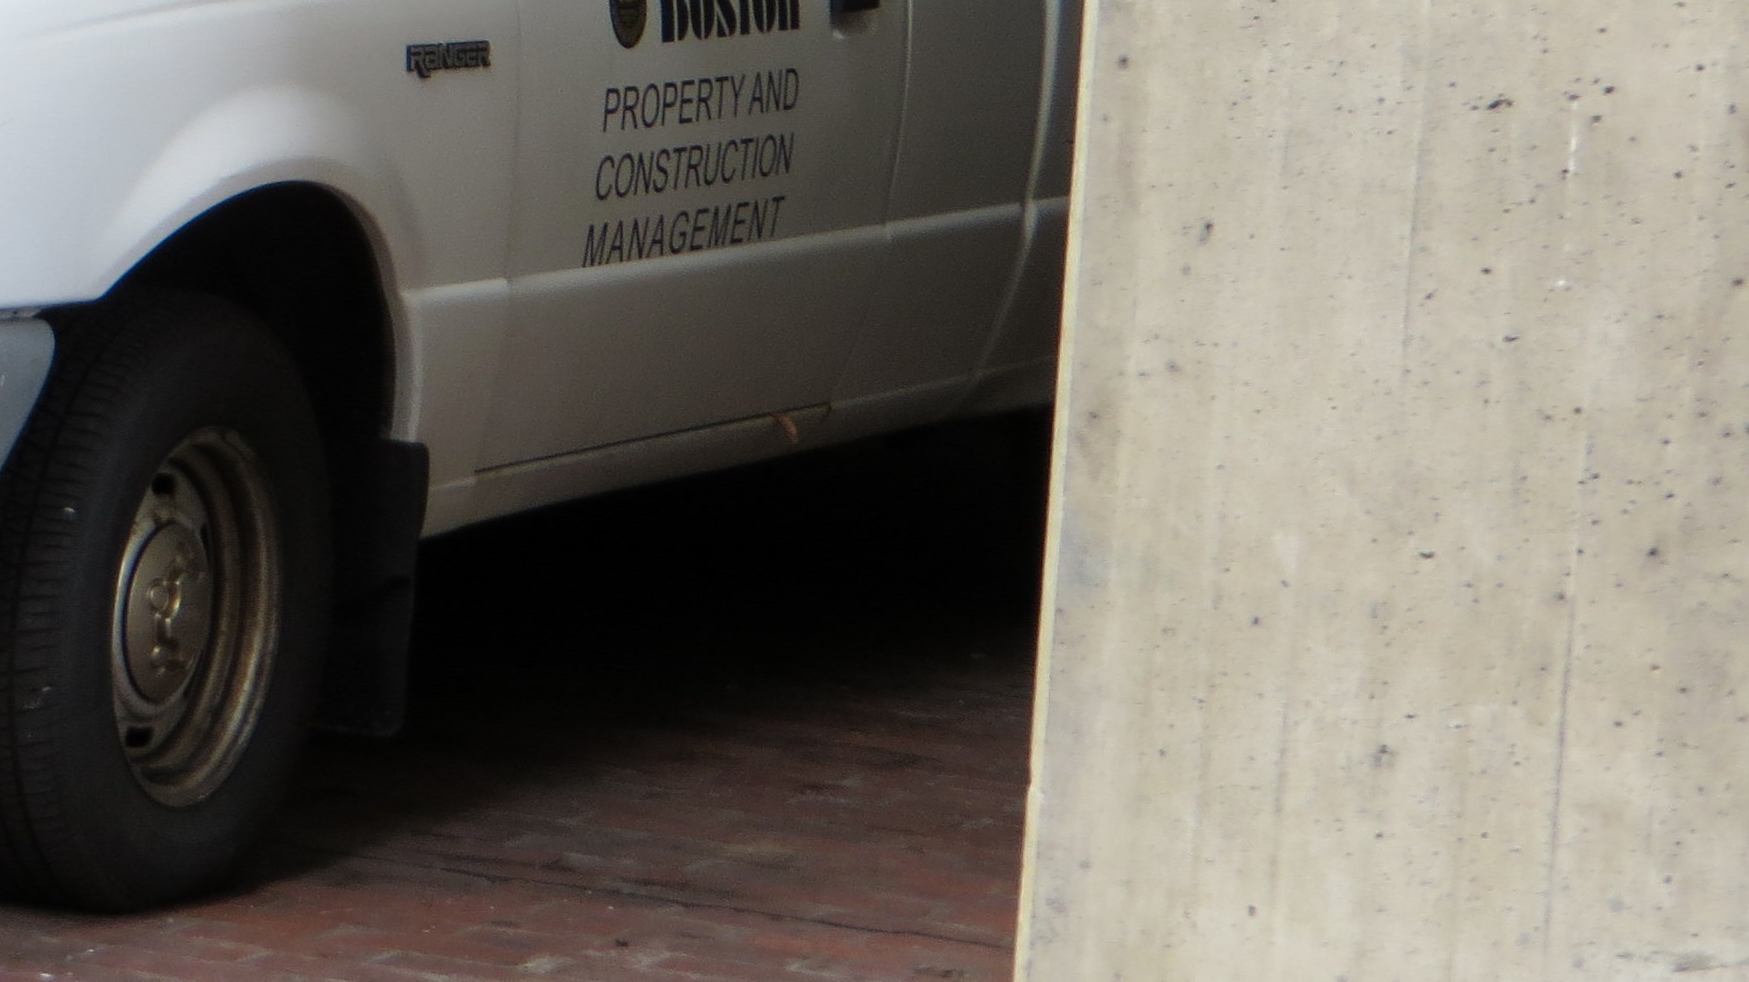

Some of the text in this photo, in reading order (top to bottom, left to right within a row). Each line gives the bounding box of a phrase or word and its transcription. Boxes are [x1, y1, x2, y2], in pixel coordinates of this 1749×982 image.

[603, 68, 800, 132] PROPERTY AND
[596, 132, 795, 201] CONSTRUCTION
[582, 196, 786, 269] MANAGEMENT
